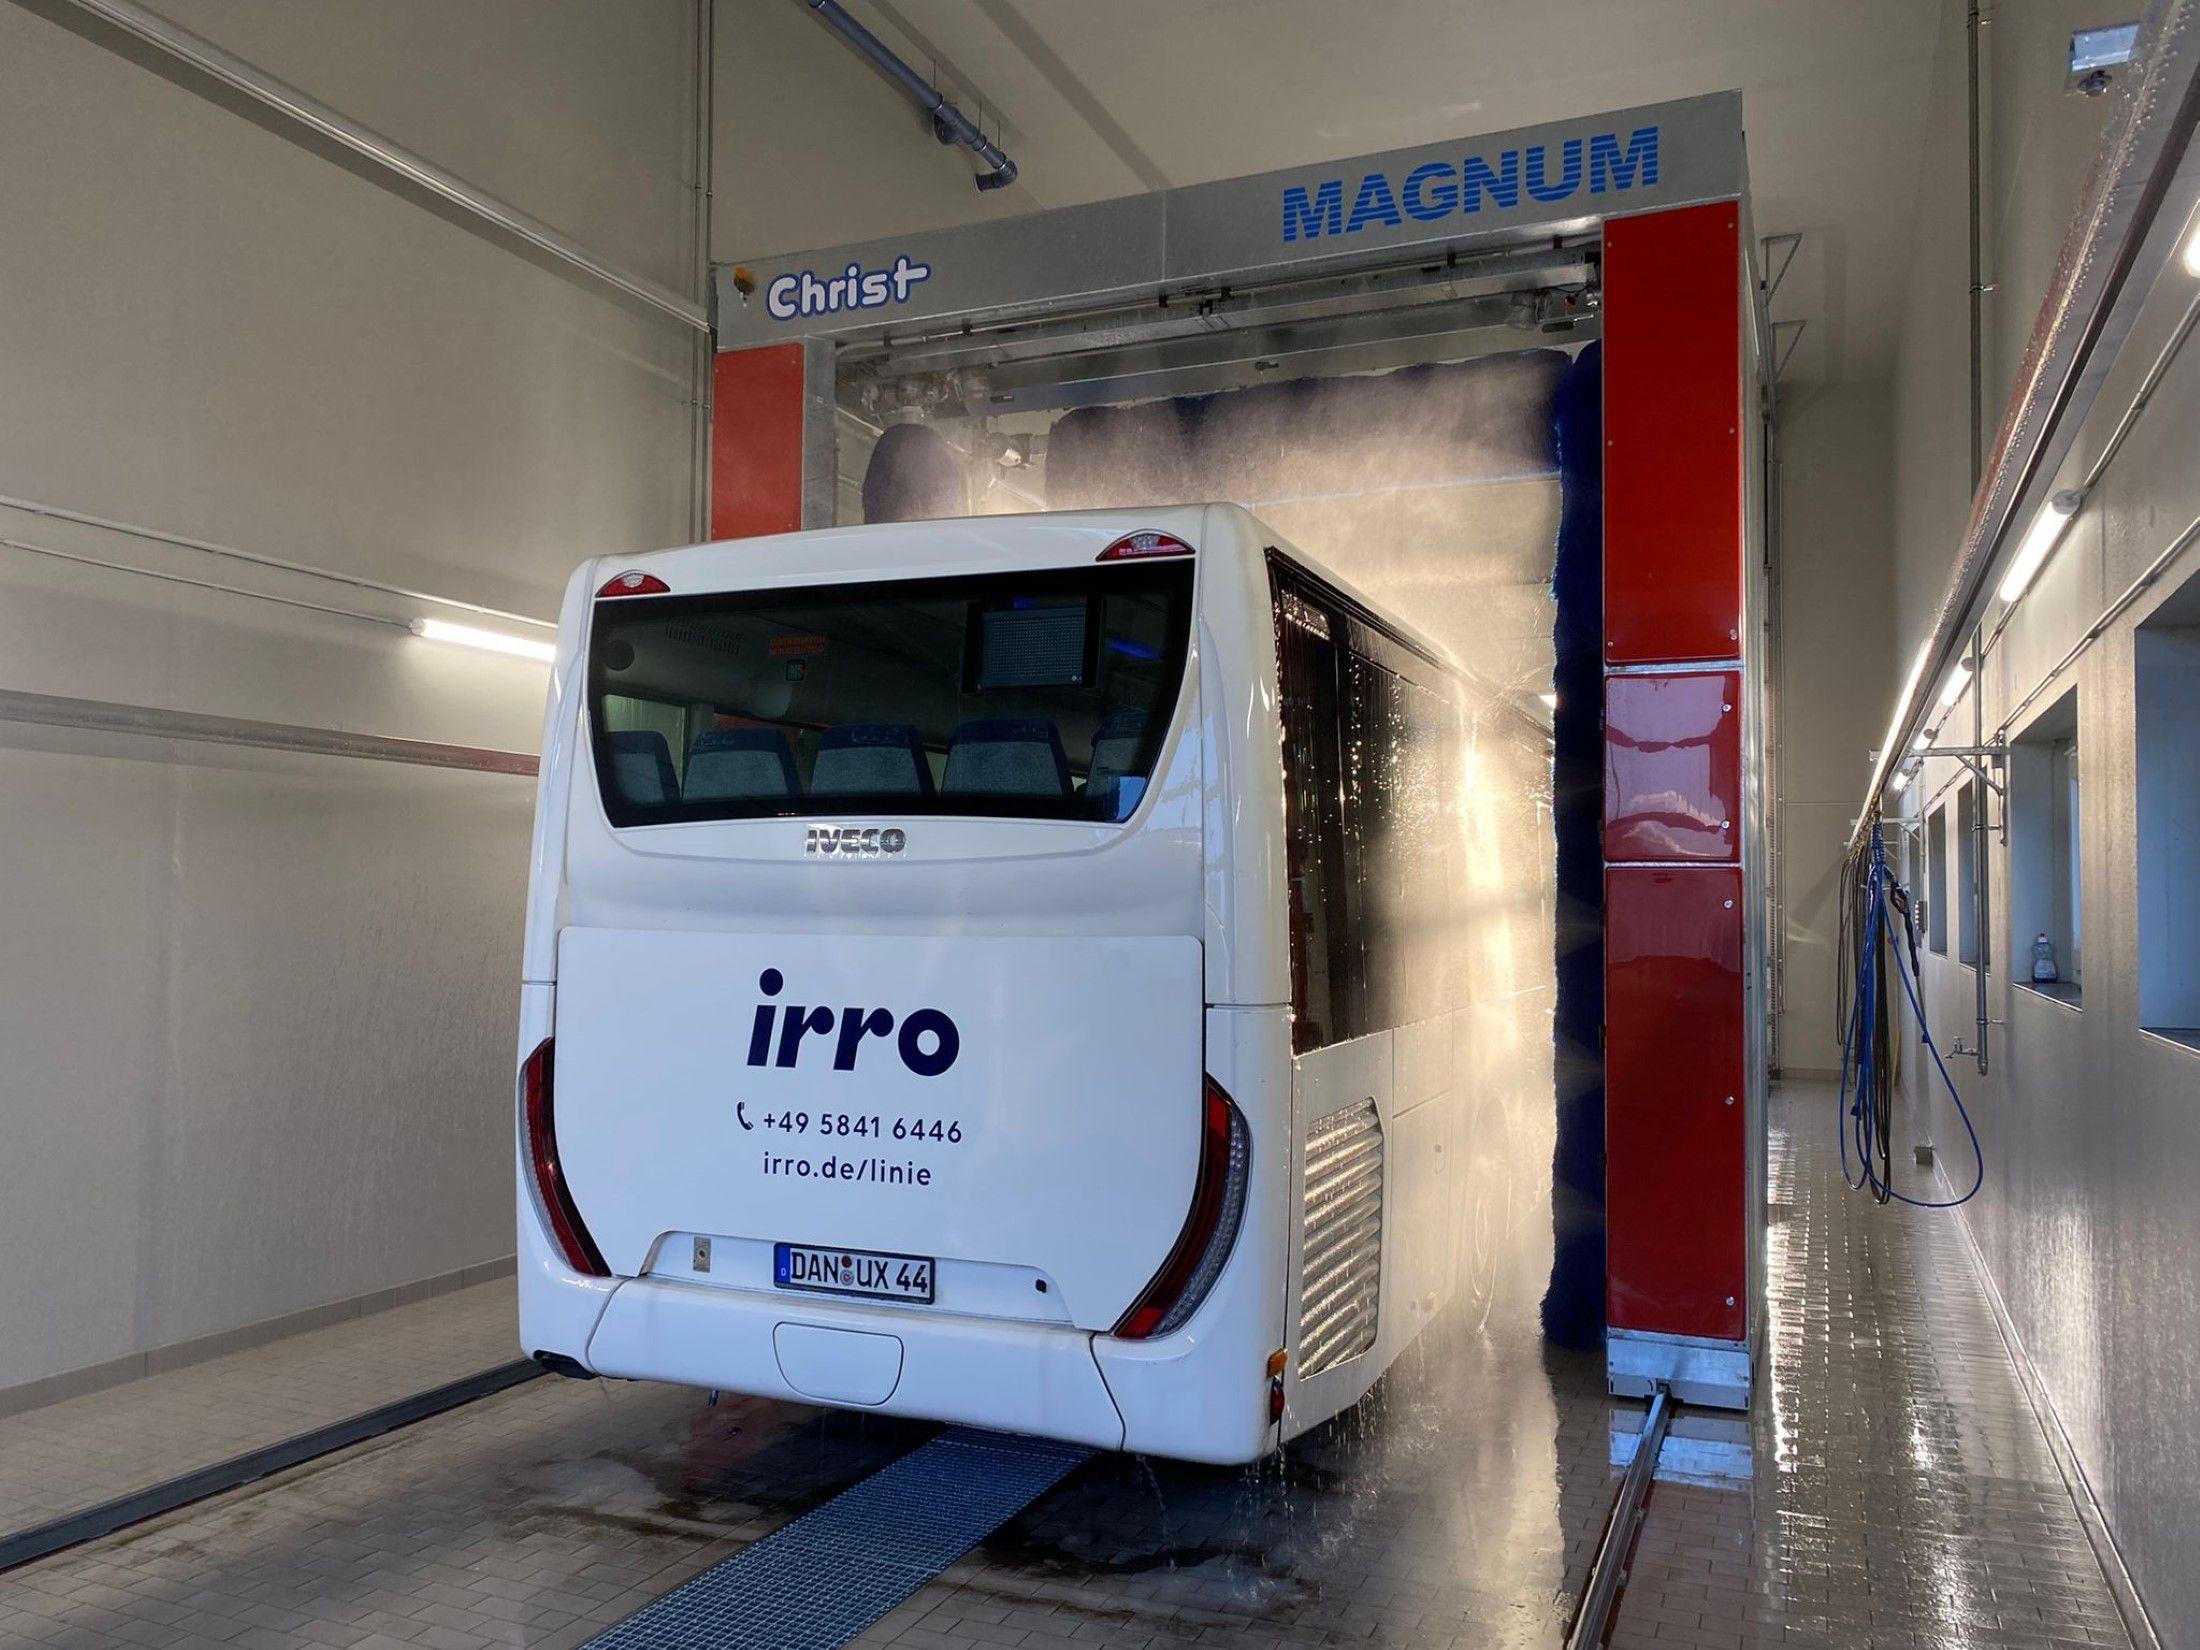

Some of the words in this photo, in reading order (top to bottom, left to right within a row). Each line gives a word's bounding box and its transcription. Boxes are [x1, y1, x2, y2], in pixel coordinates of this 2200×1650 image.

[1283, 126, 1659, 242] MAGNUM
[768, 256, 930, 320] Christ
[806, 828, 906, 853] IVECO
[746, 967, 960, 1076] irro
[763, 1111, 809, 1134] +49
[819, 1114, 880, 1138] 5841
[893, 1117, 962, 1143] 6446
[763, 1151, 931, 1186] irro.de/linie
[791, 1251, 839, 1284] DAN
[856, 1258, 889, 1290] UX
[896, 1262, 928, 1293] 44
